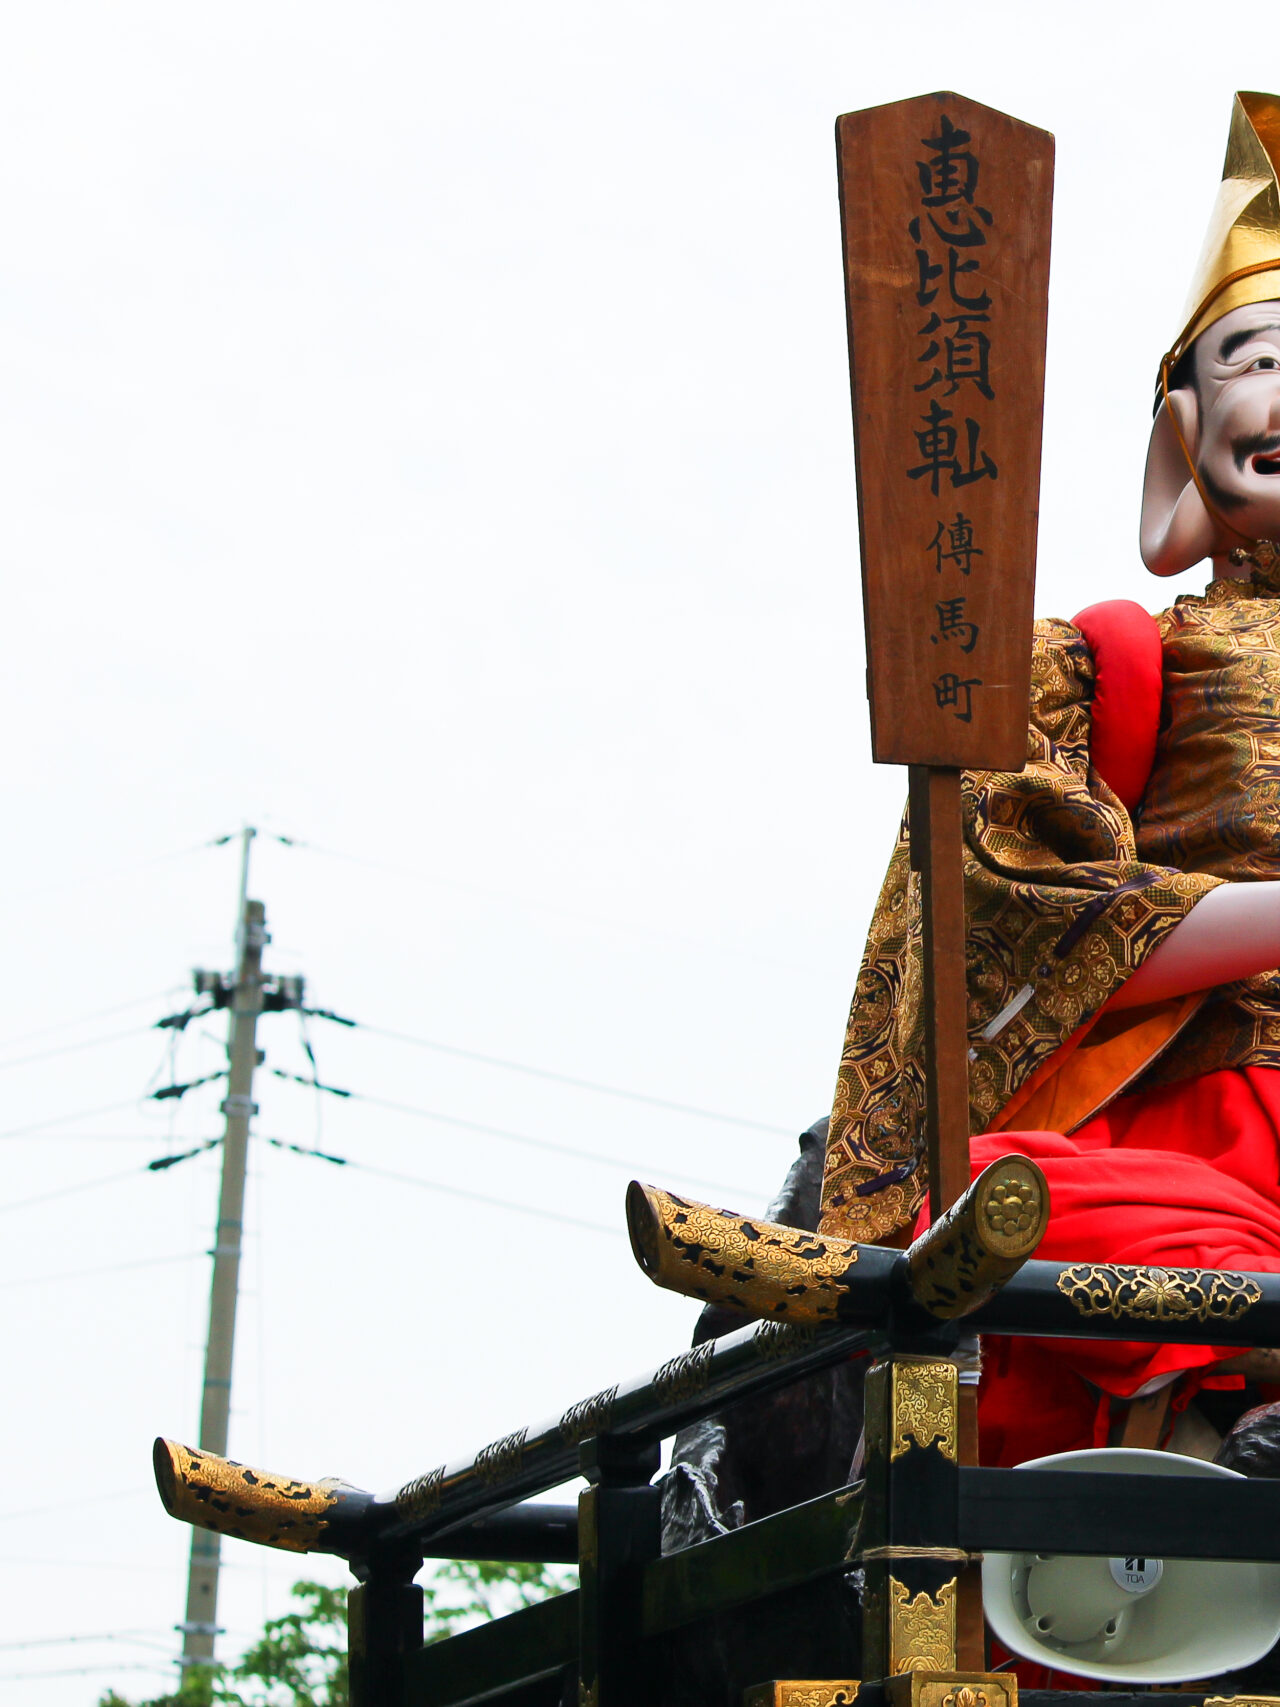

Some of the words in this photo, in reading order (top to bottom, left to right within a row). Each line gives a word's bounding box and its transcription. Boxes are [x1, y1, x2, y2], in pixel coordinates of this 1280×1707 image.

[926, 512, 983, 723] 傳馬町
[1125, 1573, 1145, 1584] TOA
